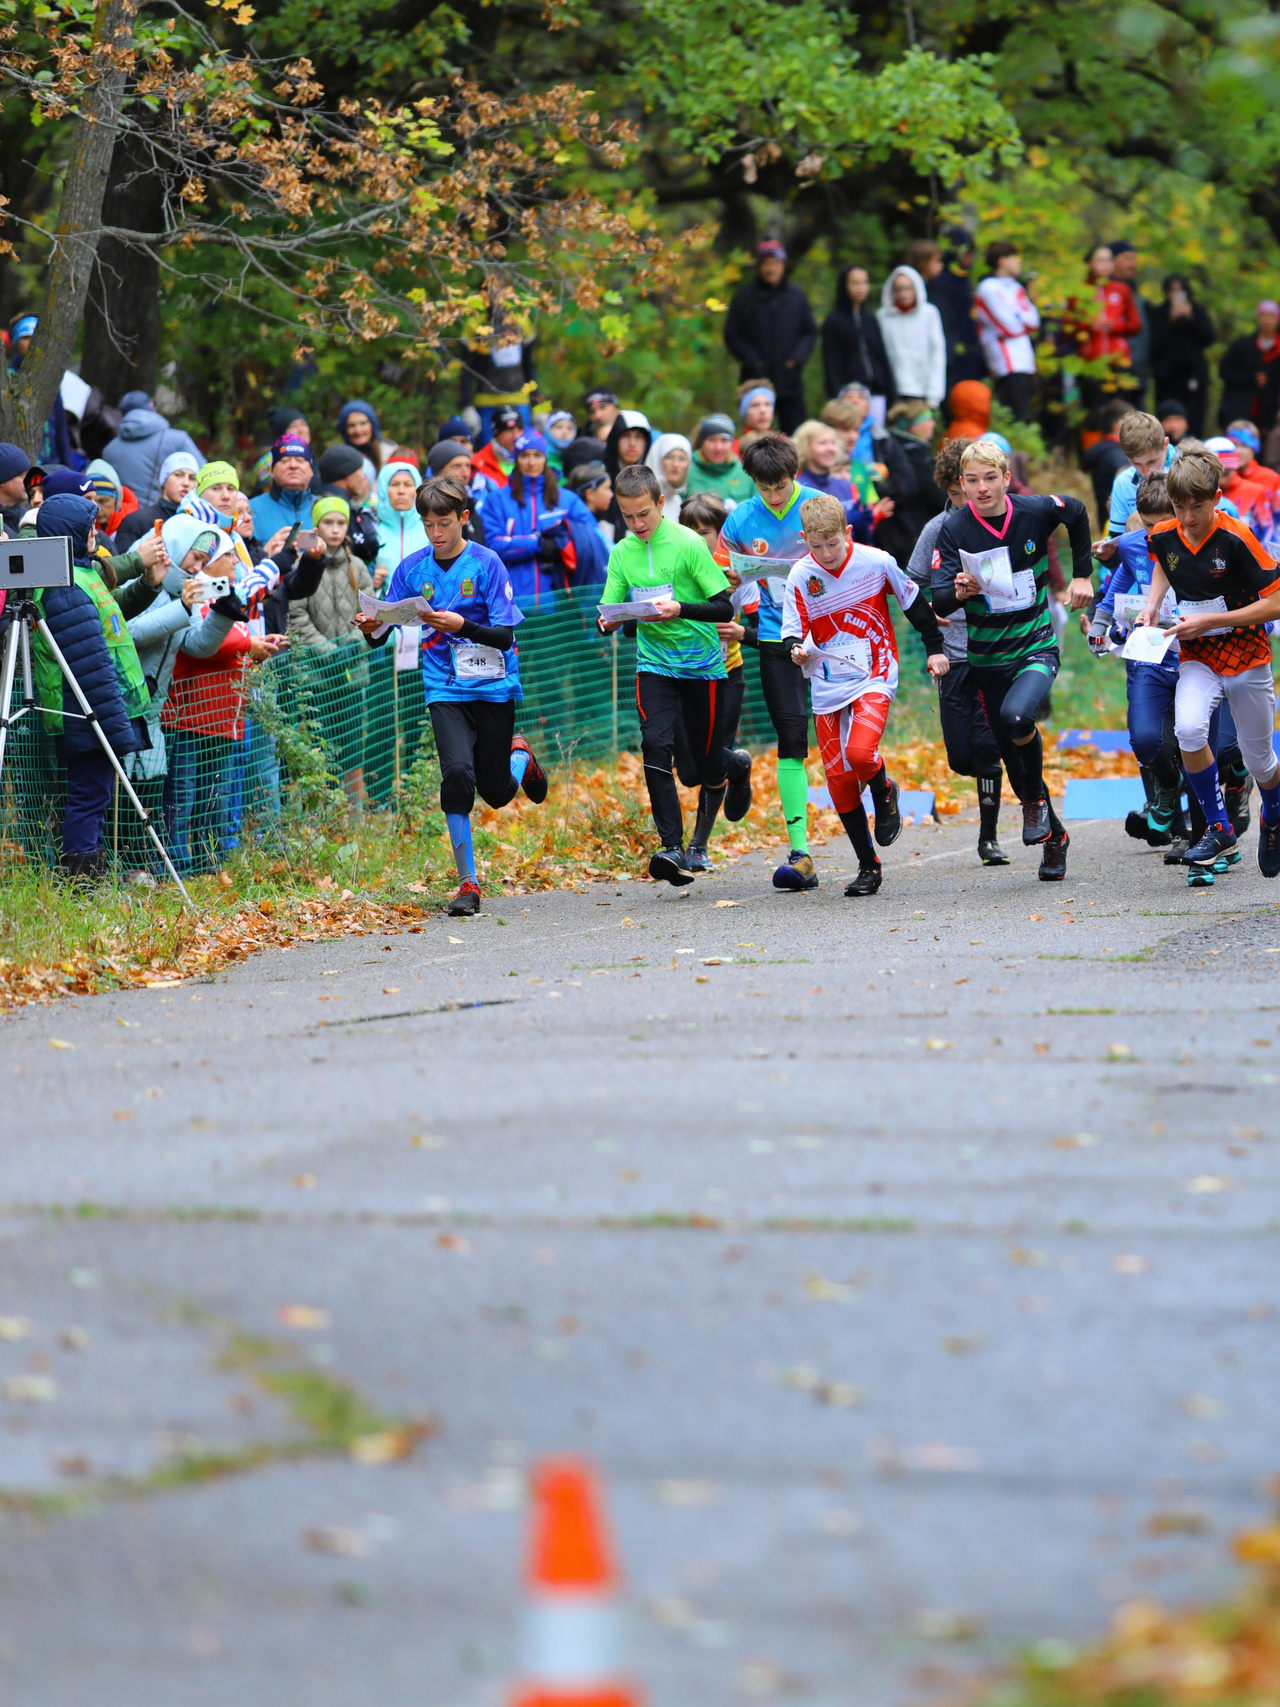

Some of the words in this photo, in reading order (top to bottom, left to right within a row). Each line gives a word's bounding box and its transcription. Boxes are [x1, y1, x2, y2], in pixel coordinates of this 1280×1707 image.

[844, 612, 867, 630] Run
[866, 627, 882, 645] and
[468, 657, 487, 667] 248
